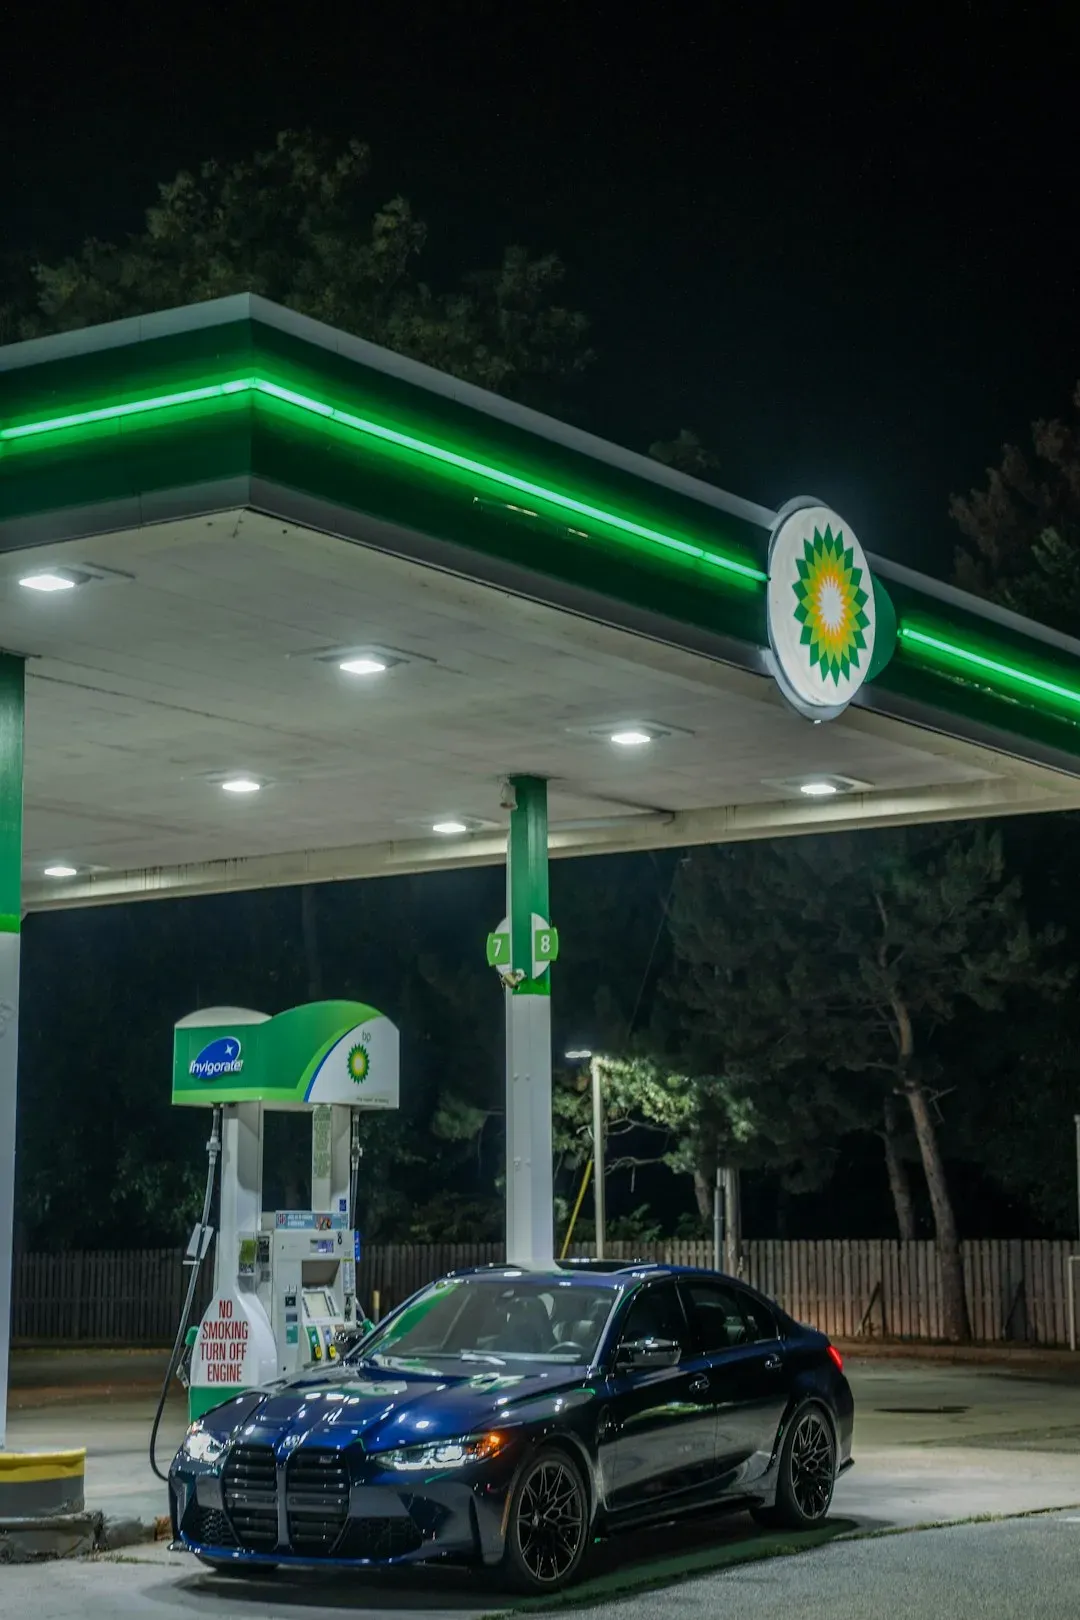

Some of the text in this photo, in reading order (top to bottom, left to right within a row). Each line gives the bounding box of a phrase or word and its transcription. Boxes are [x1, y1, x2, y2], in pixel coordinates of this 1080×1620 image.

[492, 938, 502, 957] 7
[540, 934, 551, 953] 8
[362, 1029, 372, 1044] bp
[337, 1231, 343, 1245] 8
[218, 1300, 233, 1319] NO
[202, 1320, 249, 1340] SMOKING
[200, 1342, 248, 1361] TURN OFF
[207, 1363, 243, 1382] ENGINE
